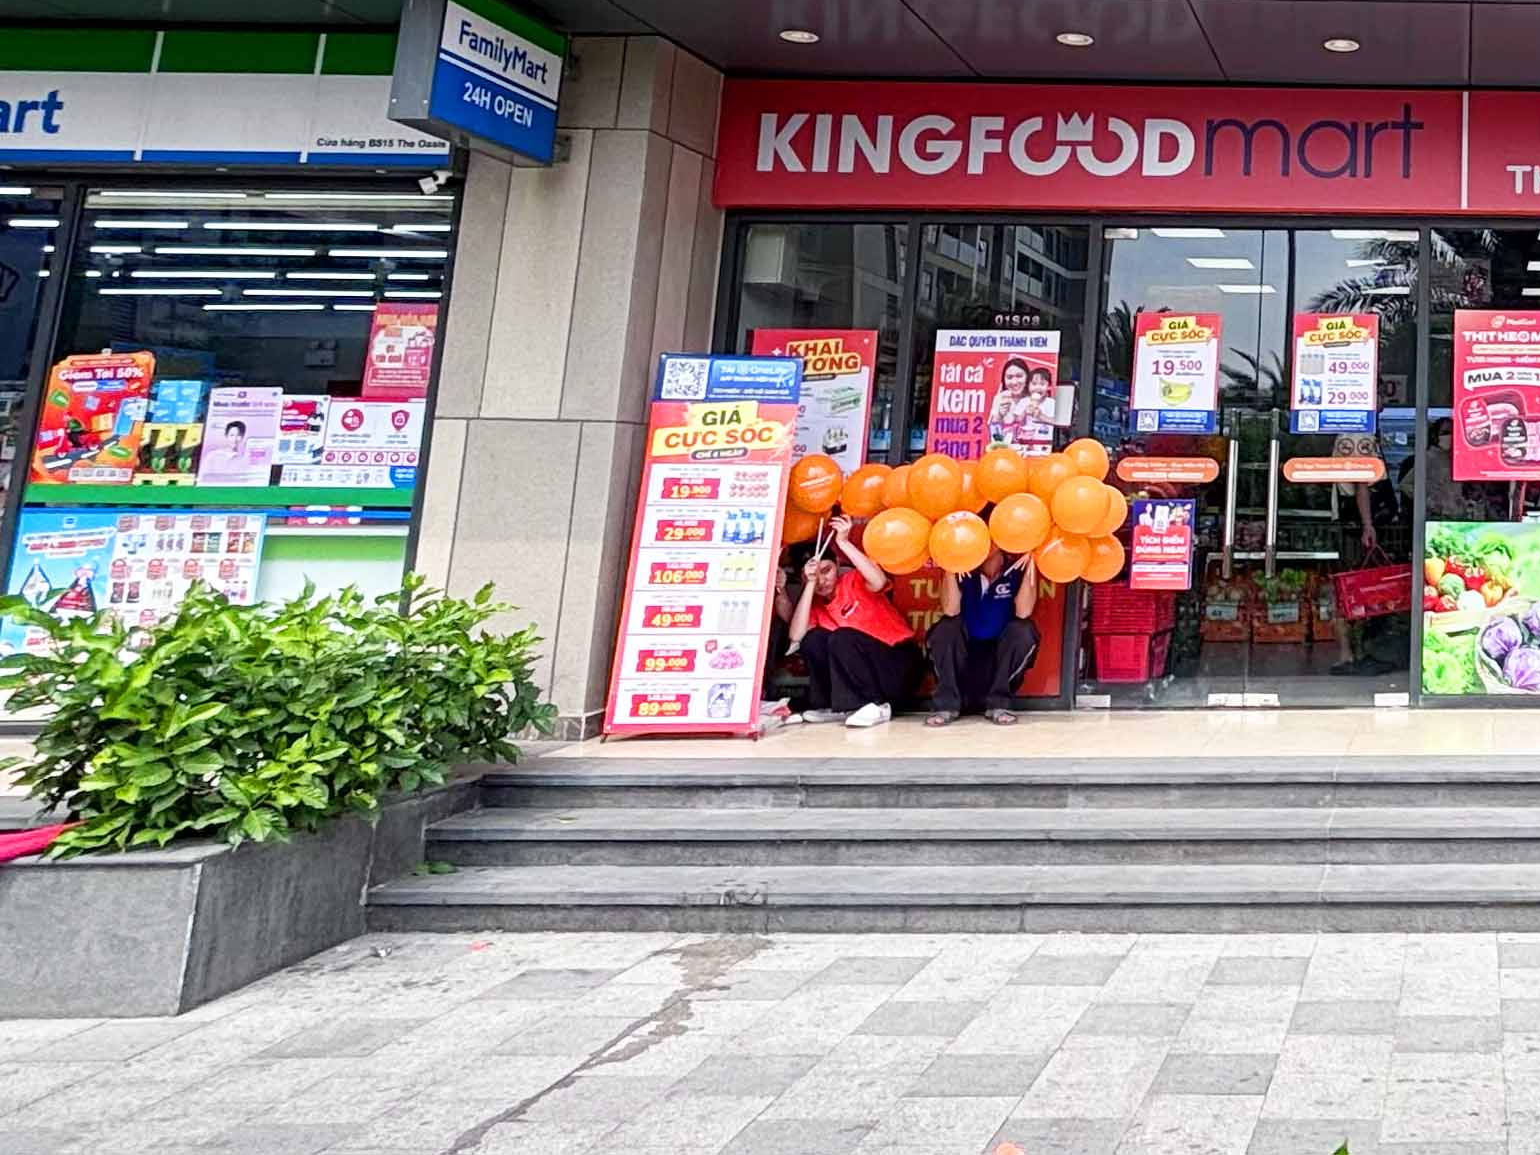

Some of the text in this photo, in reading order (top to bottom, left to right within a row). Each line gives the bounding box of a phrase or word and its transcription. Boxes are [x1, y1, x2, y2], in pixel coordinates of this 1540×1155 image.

[459, 19, 548, 85] FamilyMart
[463, 82, 533, 128] 24H OPEN
[398, 139, 415, 147] The
[1168, 320, 1189, 330] GIÁ
[1326, 320, 1346, 330] GIÁ
[1462, 331, 1497, 343] THỊT
[788, 341, 841, 357] KHAI
[803, 354, 858, 372] ƠNG
[1468, 372, 1502, 384] MUA
[1506, 372, 1515, 380] 2
[937, 386, 986, 413] kem
[702, 404, 742, 426] GIÁ
[935, 416, 983, 434] mua 2
[975, 439, 983, 460] 1
